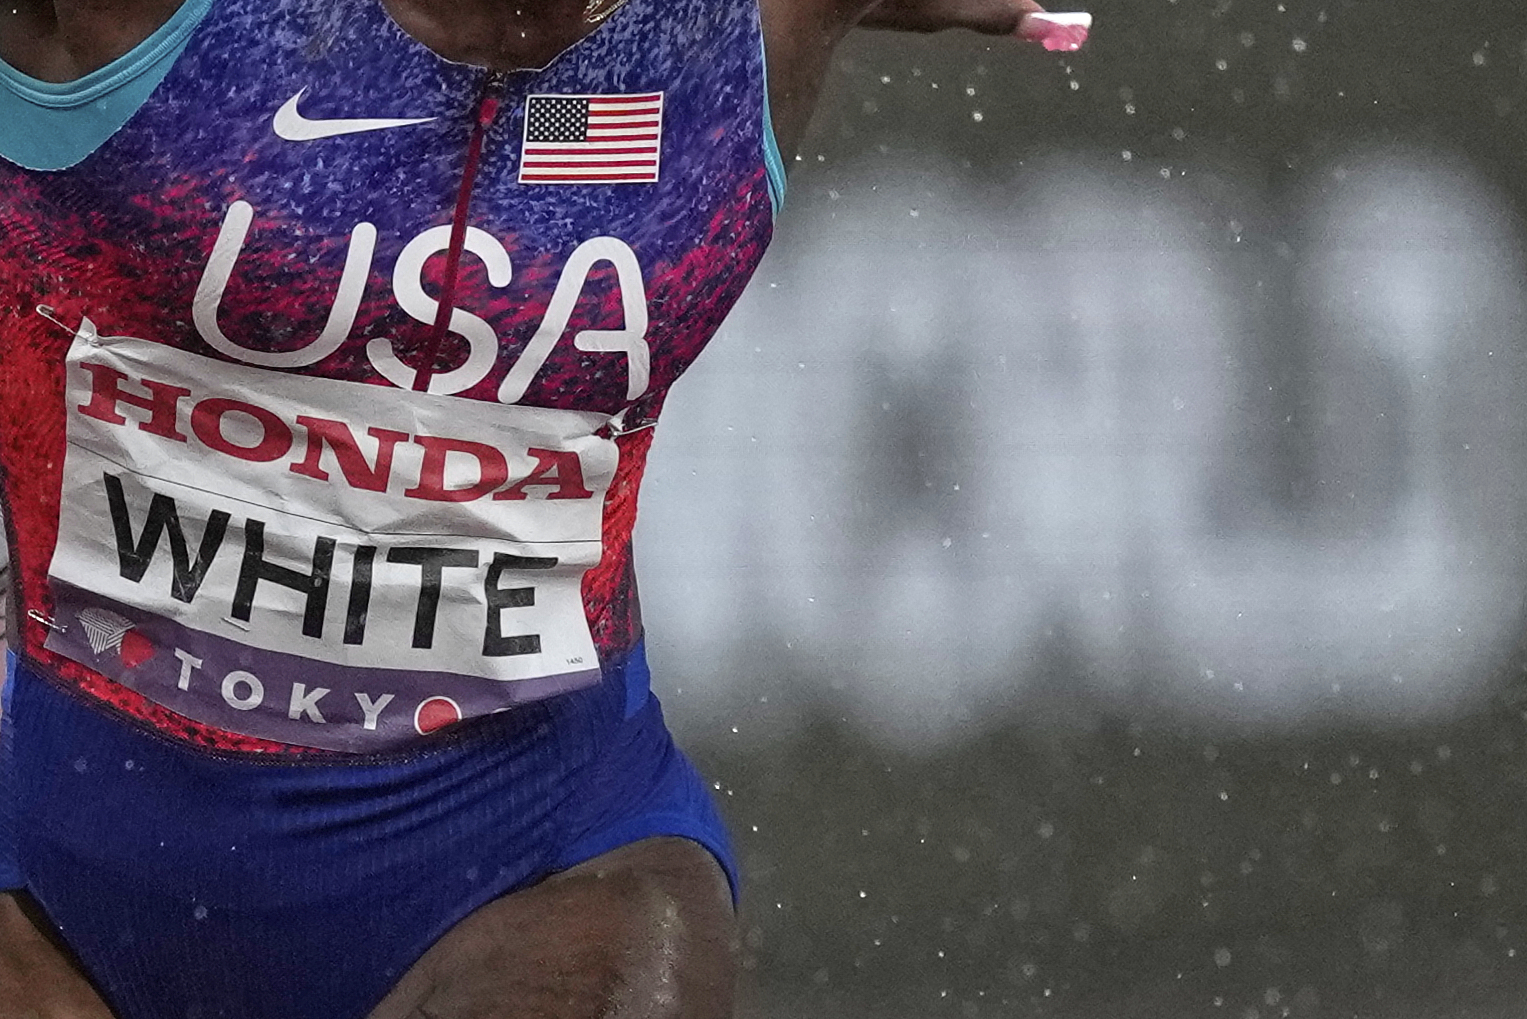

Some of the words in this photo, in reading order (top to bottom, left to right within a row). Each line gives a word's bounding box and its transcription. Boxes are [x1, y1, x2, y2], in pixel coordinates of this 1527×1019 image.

[192, 200, 650, 404] USA
[77, 362, 593, 502] HONDA
[103, 471, 559, 657] WHITE
